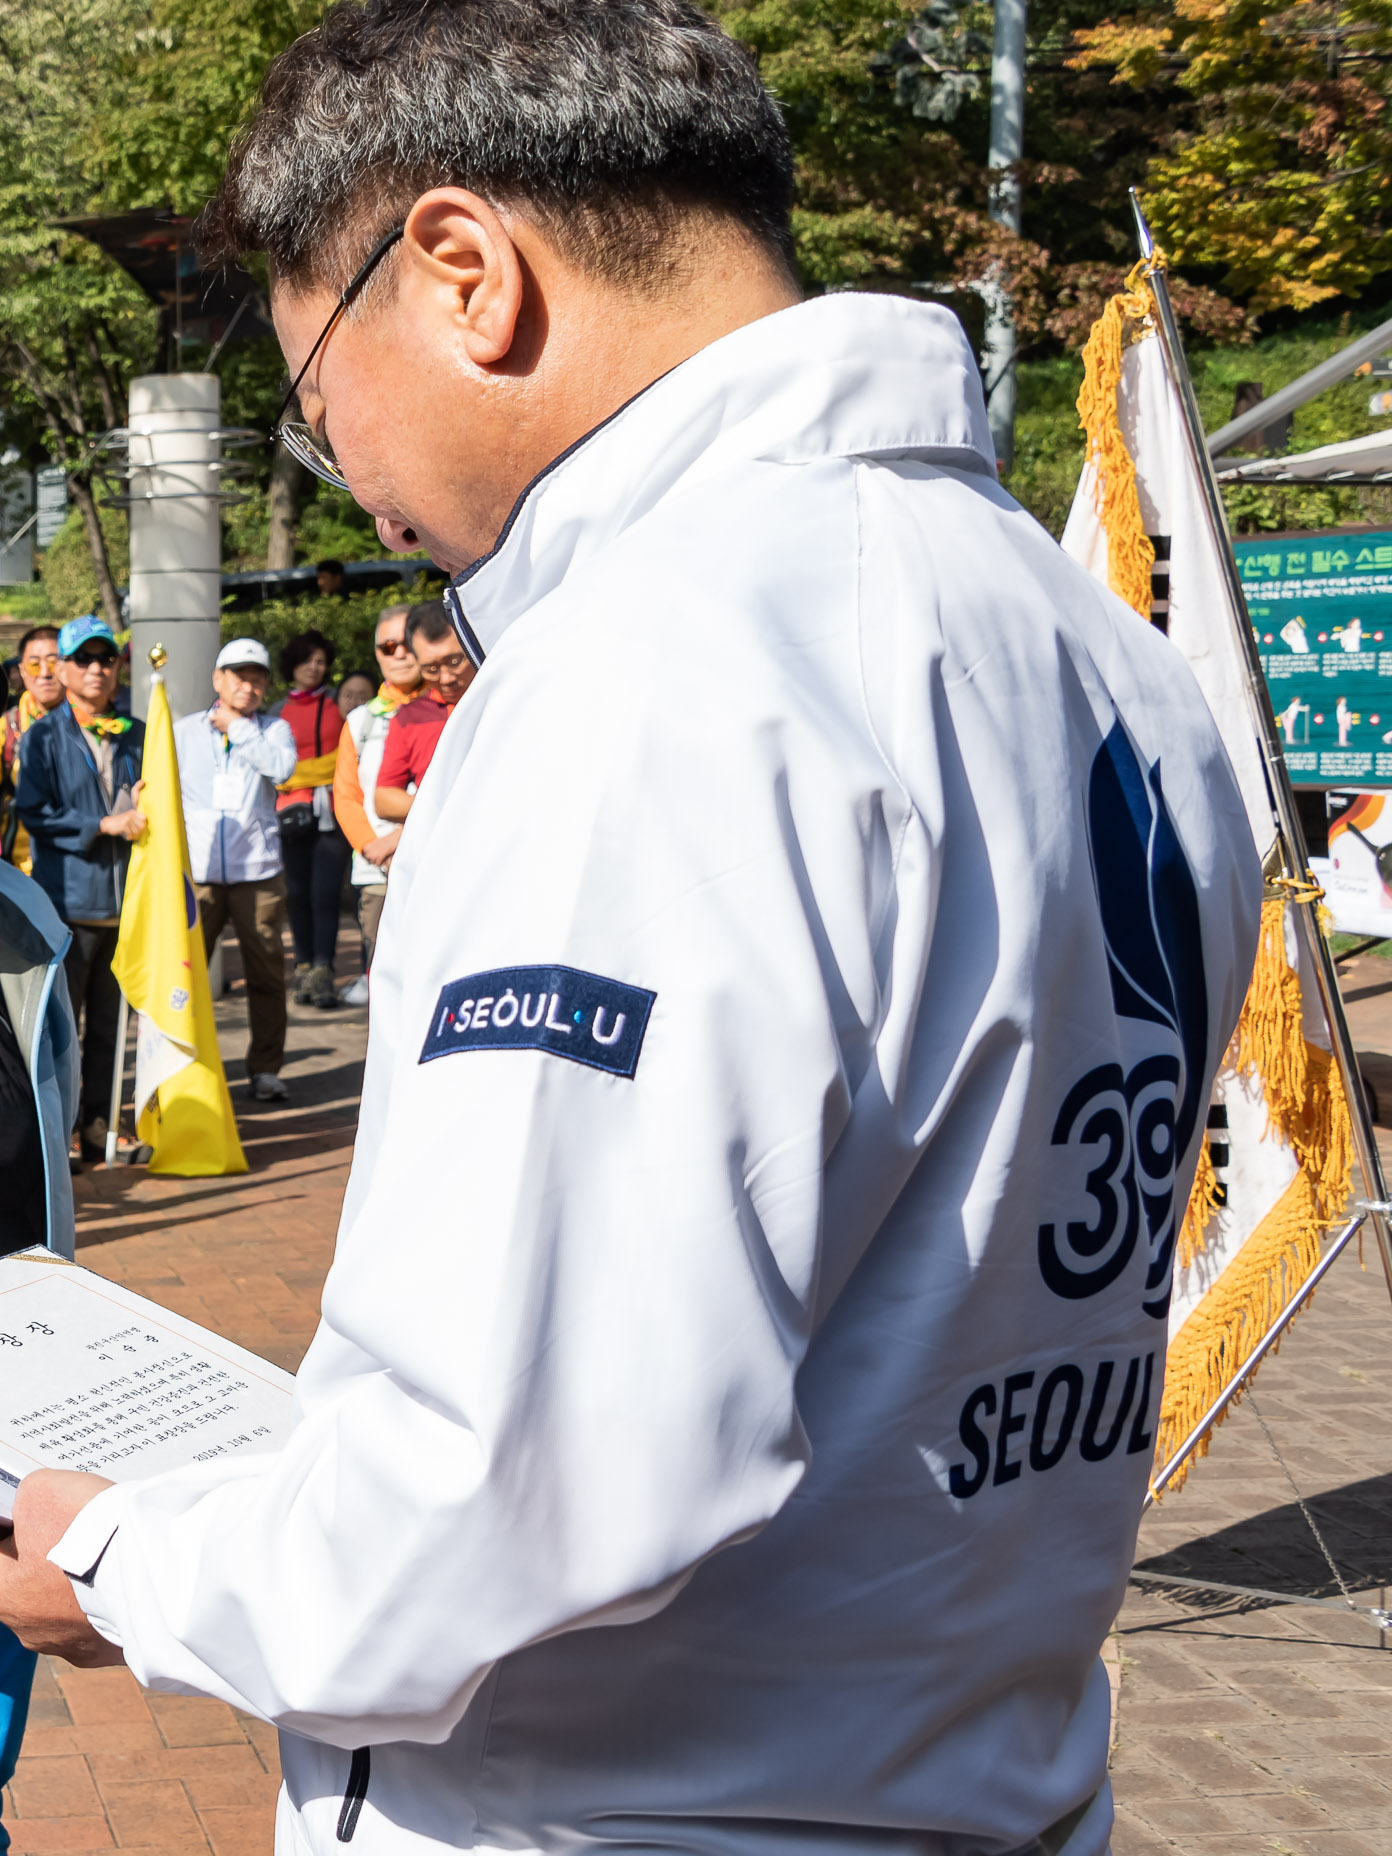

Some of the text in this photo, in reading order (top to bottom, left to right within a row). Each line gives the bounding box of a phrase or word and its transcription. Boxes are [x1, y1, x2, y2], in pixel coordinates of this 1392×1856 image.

[1243, 554, 1281, 577] 산행
[1286, 552, 1306, 574] 전
[1311, 549, 1350, 573] 필수
[9, 1351, 193, 1426] 귀하께서는 평소 헌신적인 봉사정신으로
[20, 1361, 212, 1439] 지역사회발전을 위해 노력하셨으며 특히 생활
[39, 1370, 231, 1450] 체육 활성화를 통해 구민 건강증진과 건전한
[57, 1381, 249, 1461] 여가선용에 기여한 공이 크므로 그 고마운
[949, 1351, 1156, 1500] SEOUL
[99, 1443, 144, 1464] 기리고자
[141, 1438, 157, 1446] 이
[154, 1421, 197, 1442] 표창장을
[194, 1404, 240, 1425] 드립니다.
[192, 1425, 272, 1462] 2019년 10월 6일
